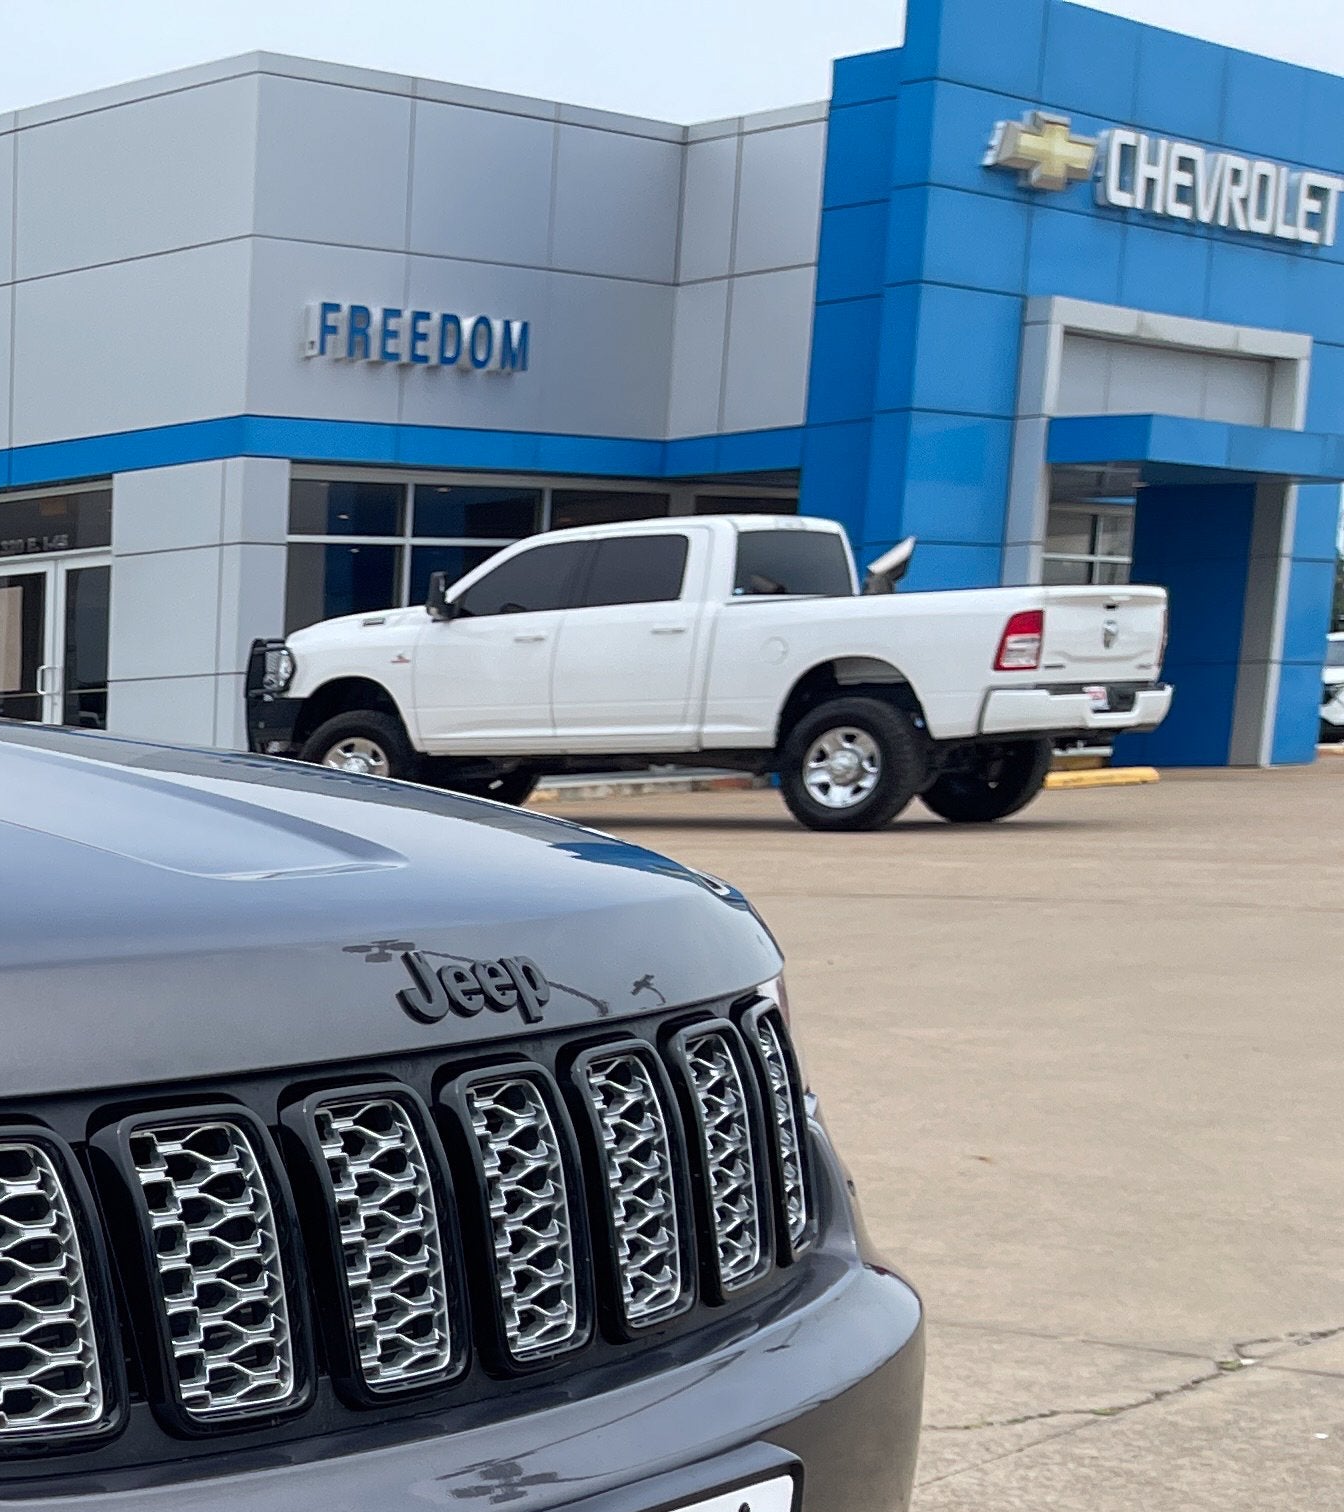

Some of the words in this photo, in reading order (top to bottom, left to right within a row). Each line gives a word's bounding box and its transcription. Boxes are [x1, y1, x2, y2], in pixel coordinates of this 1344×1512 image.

[1106, 129, 1344, 247] CHEVROLET
[316, 301, 531, 372] FREEDOM
[395, 949, 552, 1025] Jeep
